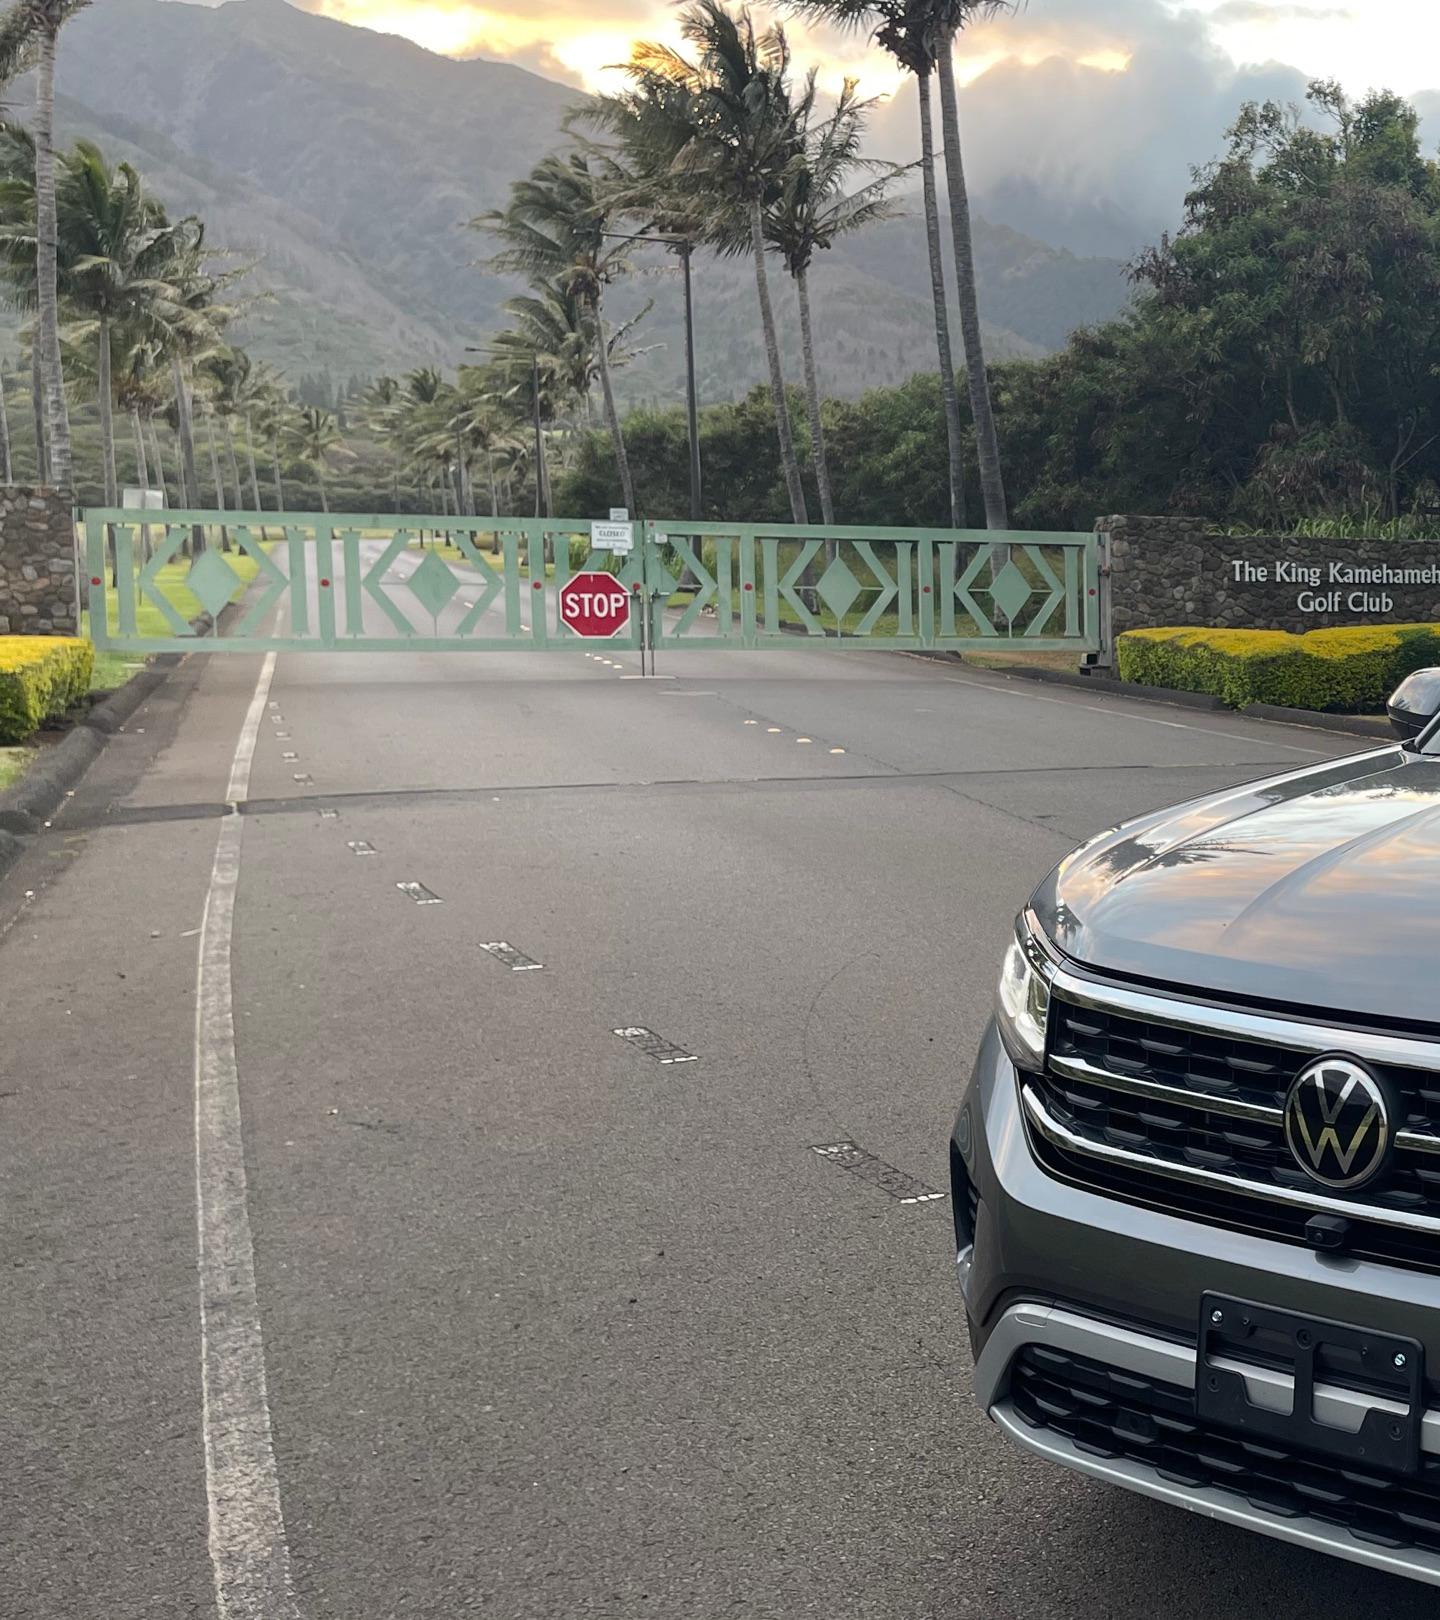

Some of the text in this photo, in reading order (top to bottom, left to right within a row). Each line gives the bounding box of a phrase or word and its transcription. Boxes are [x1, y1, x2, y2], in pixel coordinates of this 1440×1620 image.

[1231, 560, 1268, 583] The
[1275, 561, 1322, 587] King
[565, 592, 625, 618] STOP
[1297, 591, 1394, 613] Golf Club
[1290, 1066, 1381, 1176] VW
